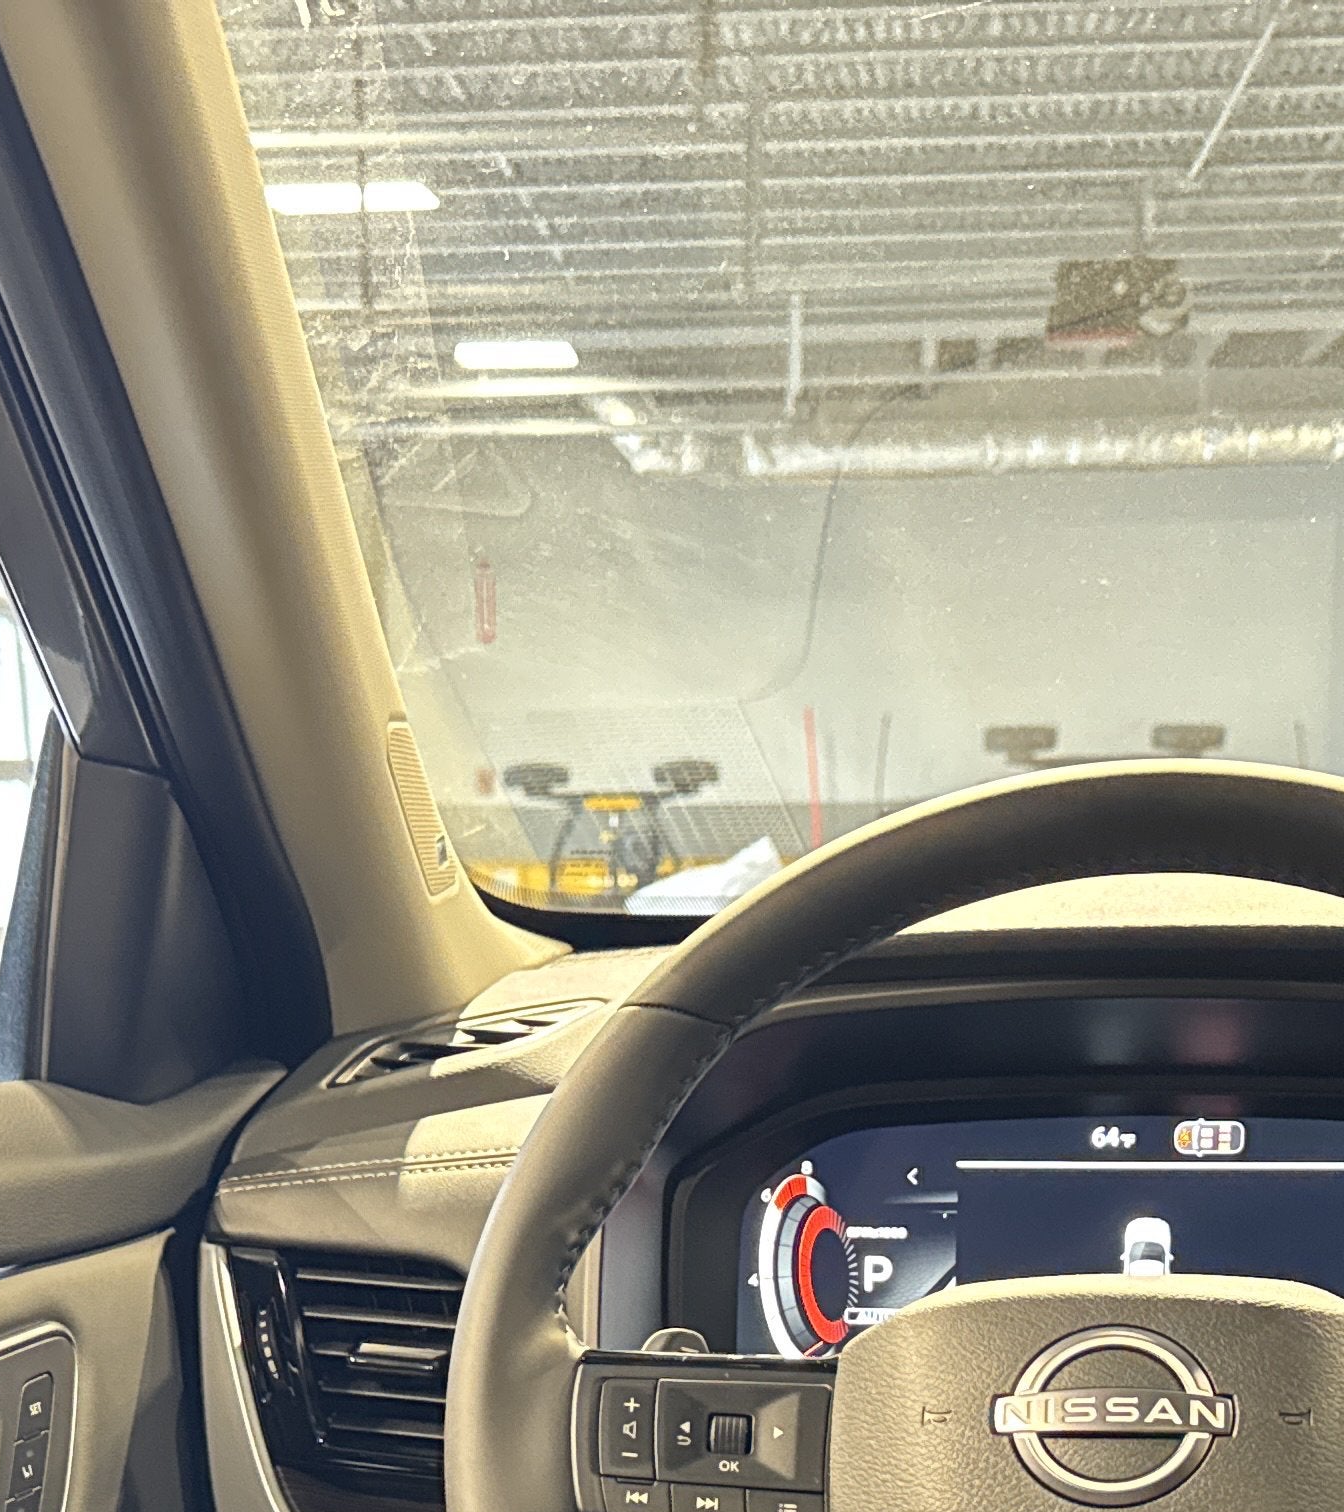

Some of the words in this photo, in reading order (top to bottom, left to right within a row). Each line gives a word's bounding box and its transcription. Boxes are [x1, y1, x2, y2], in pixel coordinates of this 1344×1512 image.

[800, 1160, 813, 1175] 8
[760, 1188, 772, 1203] 6
[863, 1255, 893, 1292] P
[1003, 1396, 1225, 1429] NISSAN
[718, 1459, 740, 1473] OK
